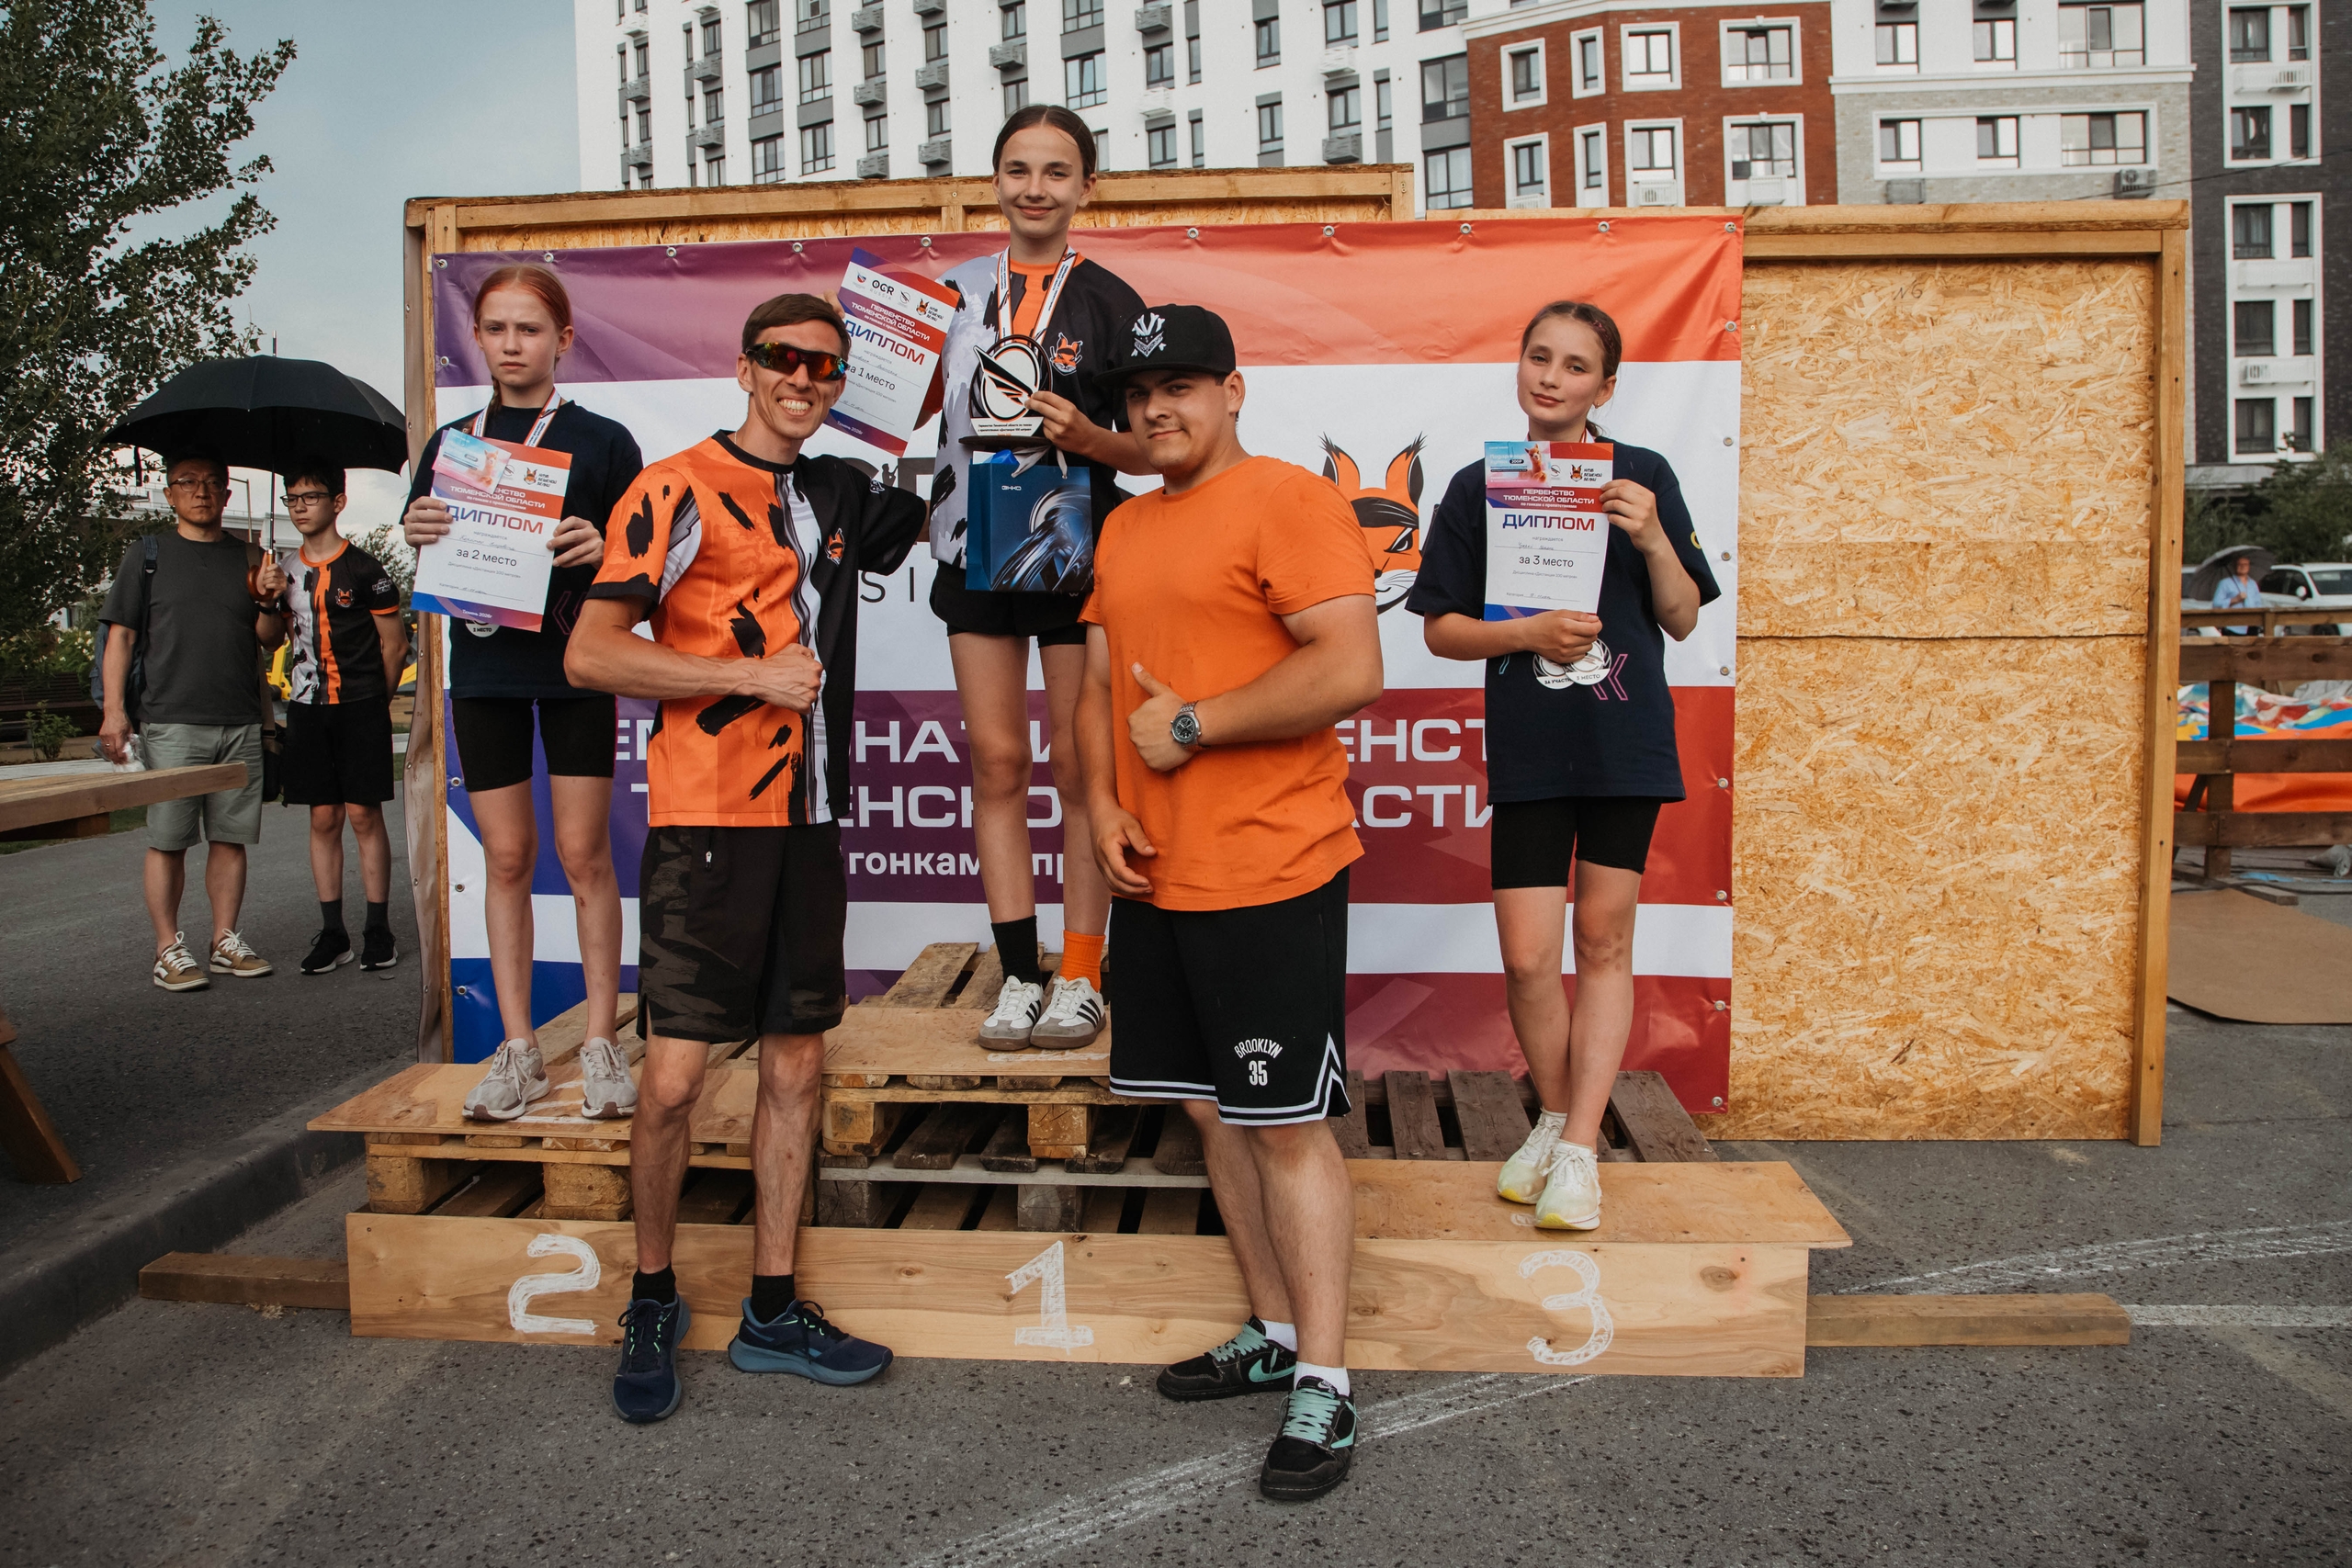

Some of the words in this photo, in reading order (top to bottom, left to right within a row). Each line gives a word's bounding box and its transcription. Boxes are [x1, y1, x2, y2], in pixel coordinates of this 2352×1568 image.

[872, 280, 894, 296] OCR
[852, 302, 897, 325] ТЮМЕНСКОЙ
[897, 321, 931, 341] ОБЛАСТИ
[870, 303, 916, 327] ПЕРВЕНСТВО
[845, 320, 925, 365] ДИПЛОМ
[858, 368, 864, 377] 1
[865, 373, 896, 390] место
[450, 486, 504, 502] ТЮМЕНСКОЙ
[505, 497, 546, 509] ОБЛАСТИ
[447, 505, 544, 535] ДИПЛОМ
[1502, 513, 1595, 531] ДИПЛОМ
[457, 549, 469, 558] за
[471, 549, 480, 559] 2
[482, 554, 517, 567] место
[1519, 556, 1530, 564] за
[1533, 555, 1540, 565] 3
[1543, 558, 1574, 568] место
[1234, 1038, 1283, 1058] BROOKLYN
[1249, 1060, 1268, 1087] 35
[508, 1232, 601, 1336] 2
[1005, 1240, 1094, 1354] 1
[1519, 1250, 1613, 1366] 3
